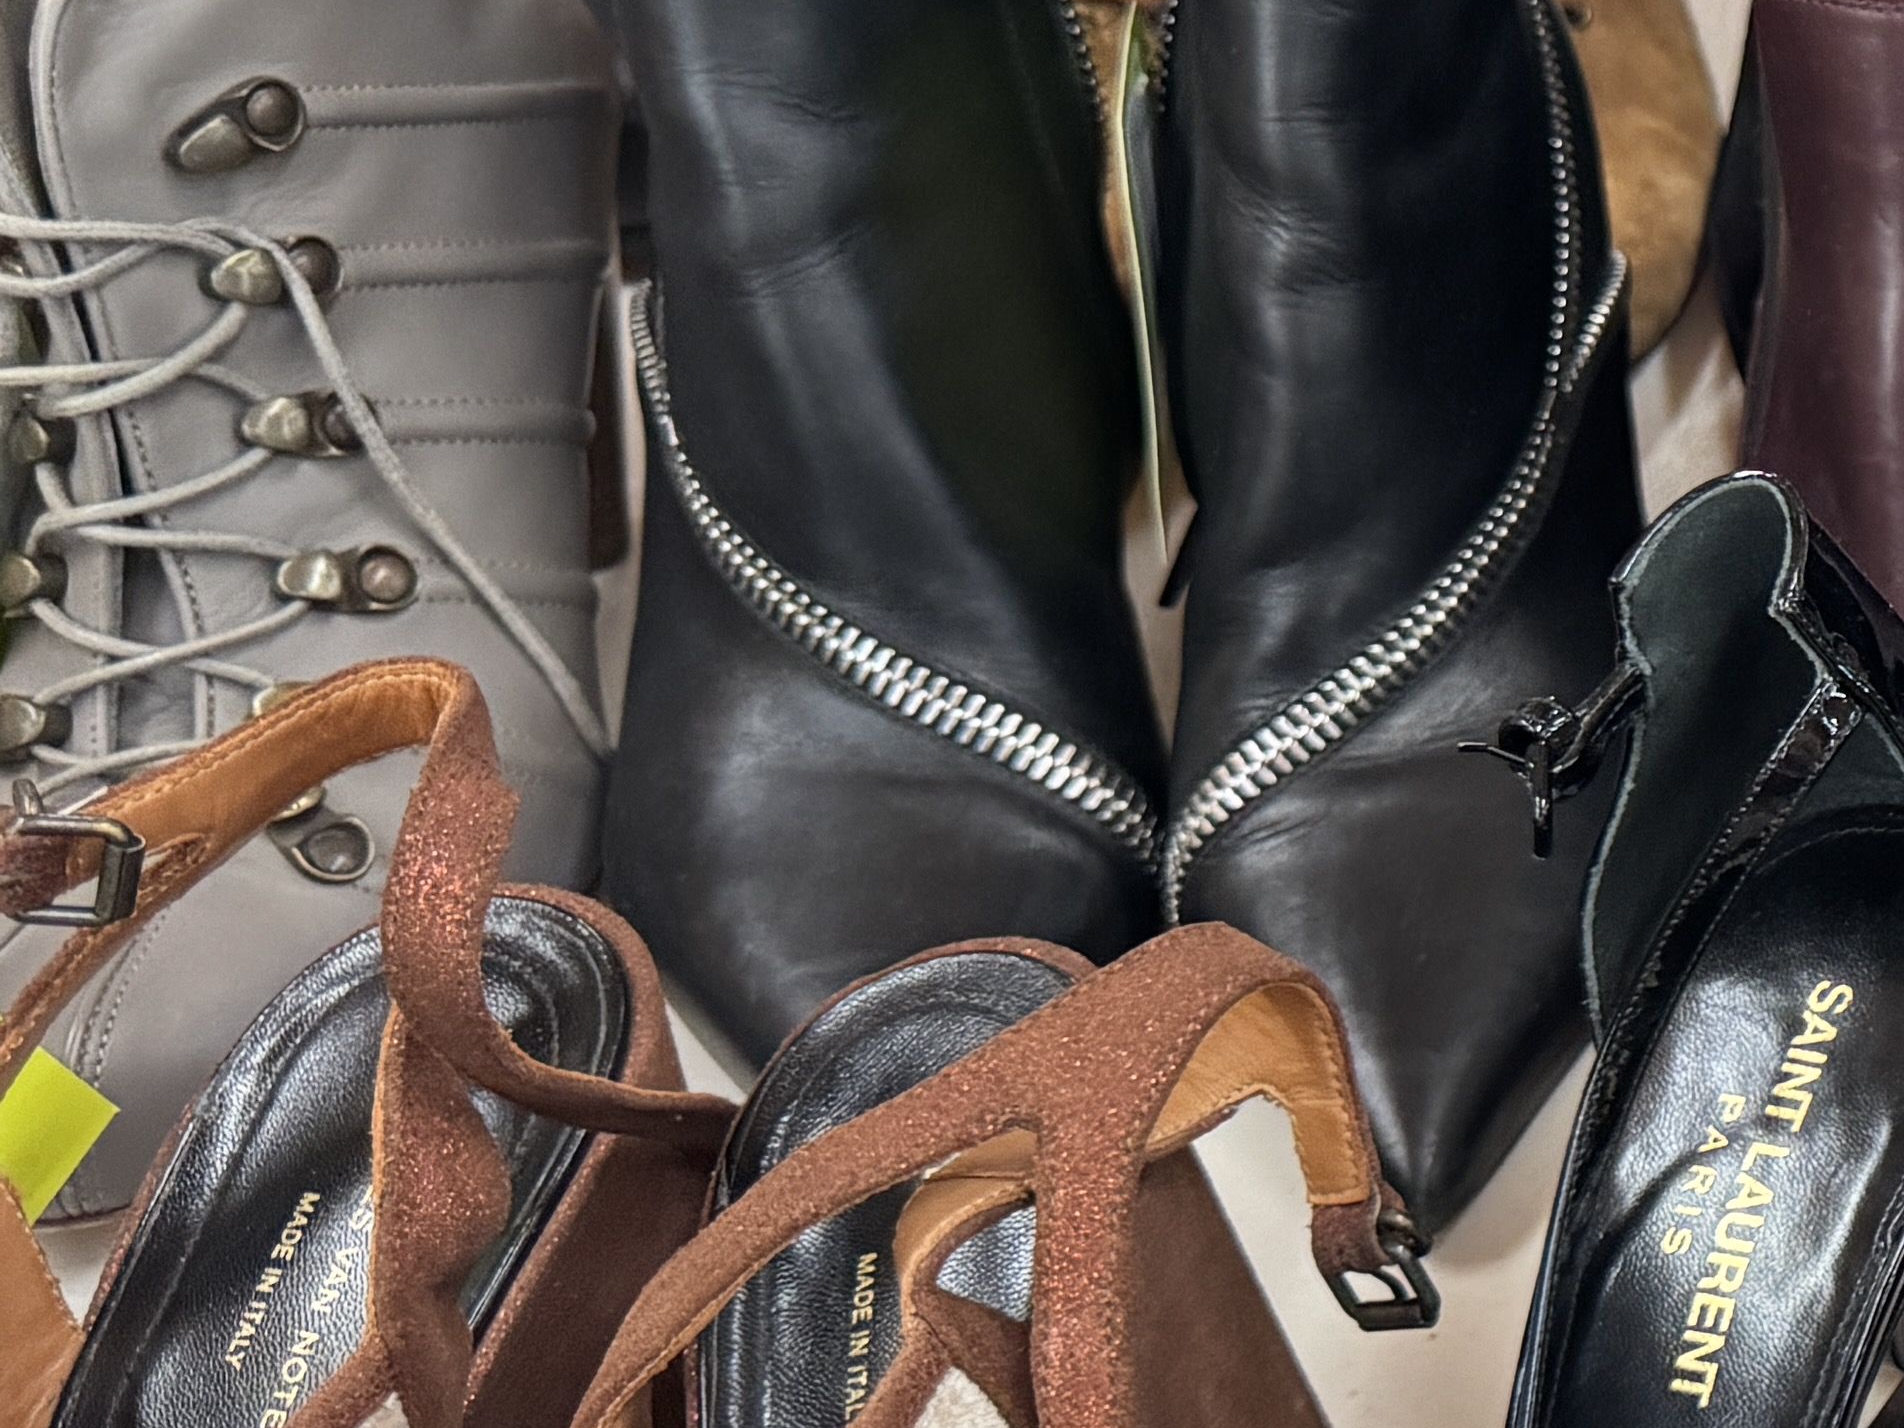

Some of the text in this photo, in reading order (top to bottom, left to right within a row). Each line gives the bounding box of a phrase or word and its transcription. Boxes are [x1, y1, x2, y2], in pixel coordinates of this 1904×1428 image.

[1660, 1091, 1746, 1256] PARIS
[1670, 979, 1854, 1409] SAINT LAURENT
[224, 1191, 321, 1371] MADE IN ITALY
[311, 1244, 359, 1314] VAN
[844, 1252, 879, 1421] MADE IN ITAL
